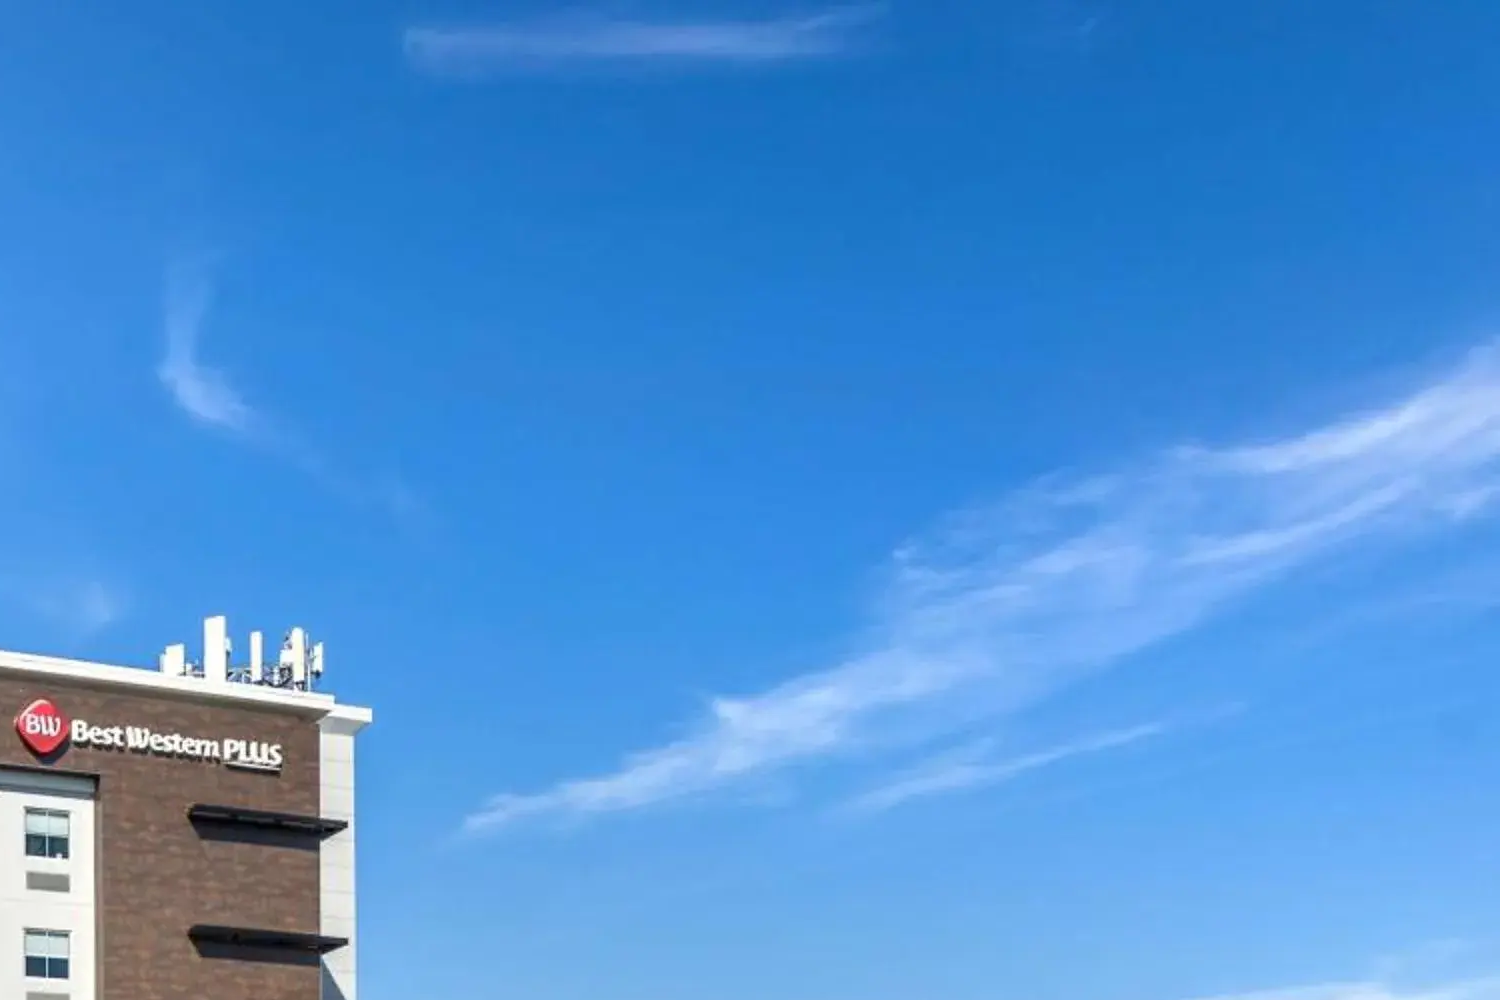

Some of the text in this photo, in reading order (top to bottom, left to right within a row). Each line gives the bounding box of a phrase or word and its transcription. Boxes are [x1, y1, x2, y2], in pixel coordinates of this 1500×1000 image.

[25, 713, 61, 737] BW
[71, 719, 282, 765] Best Western PLUS
